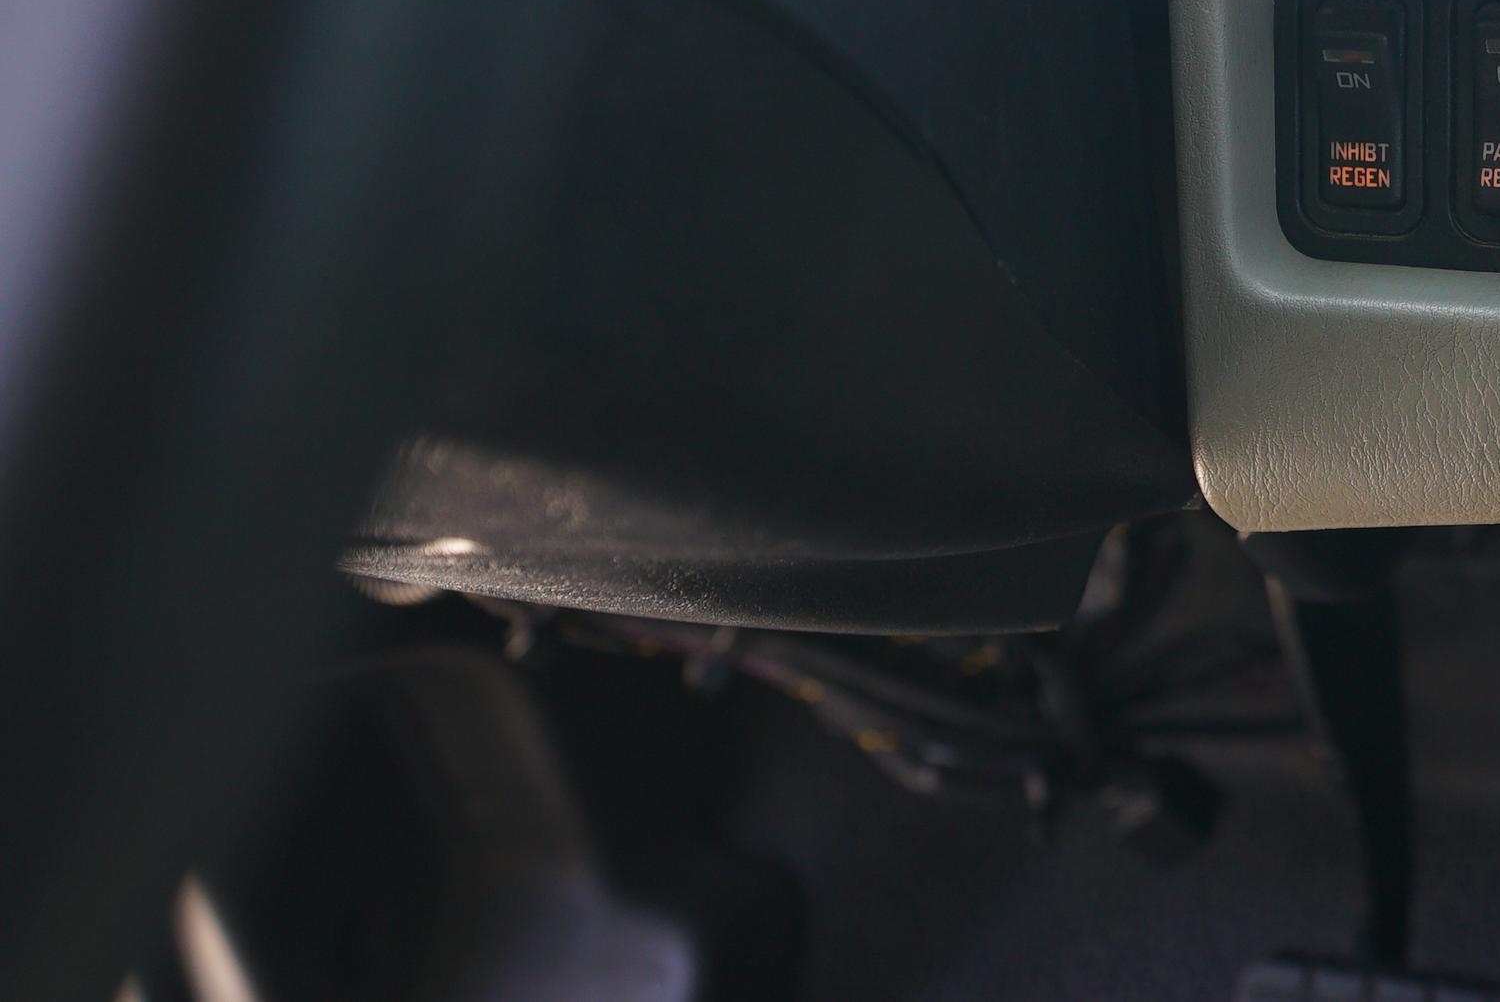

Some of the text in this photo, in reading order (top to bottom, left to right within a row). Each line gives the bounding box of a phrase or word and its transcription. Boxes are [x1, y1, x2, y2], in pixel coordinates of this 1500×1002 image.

[1336, 72, 1370, 90] ON
[1330, 142, 1390, 163] INHIBT
[1329, 167, 1391, 188] REGEN
